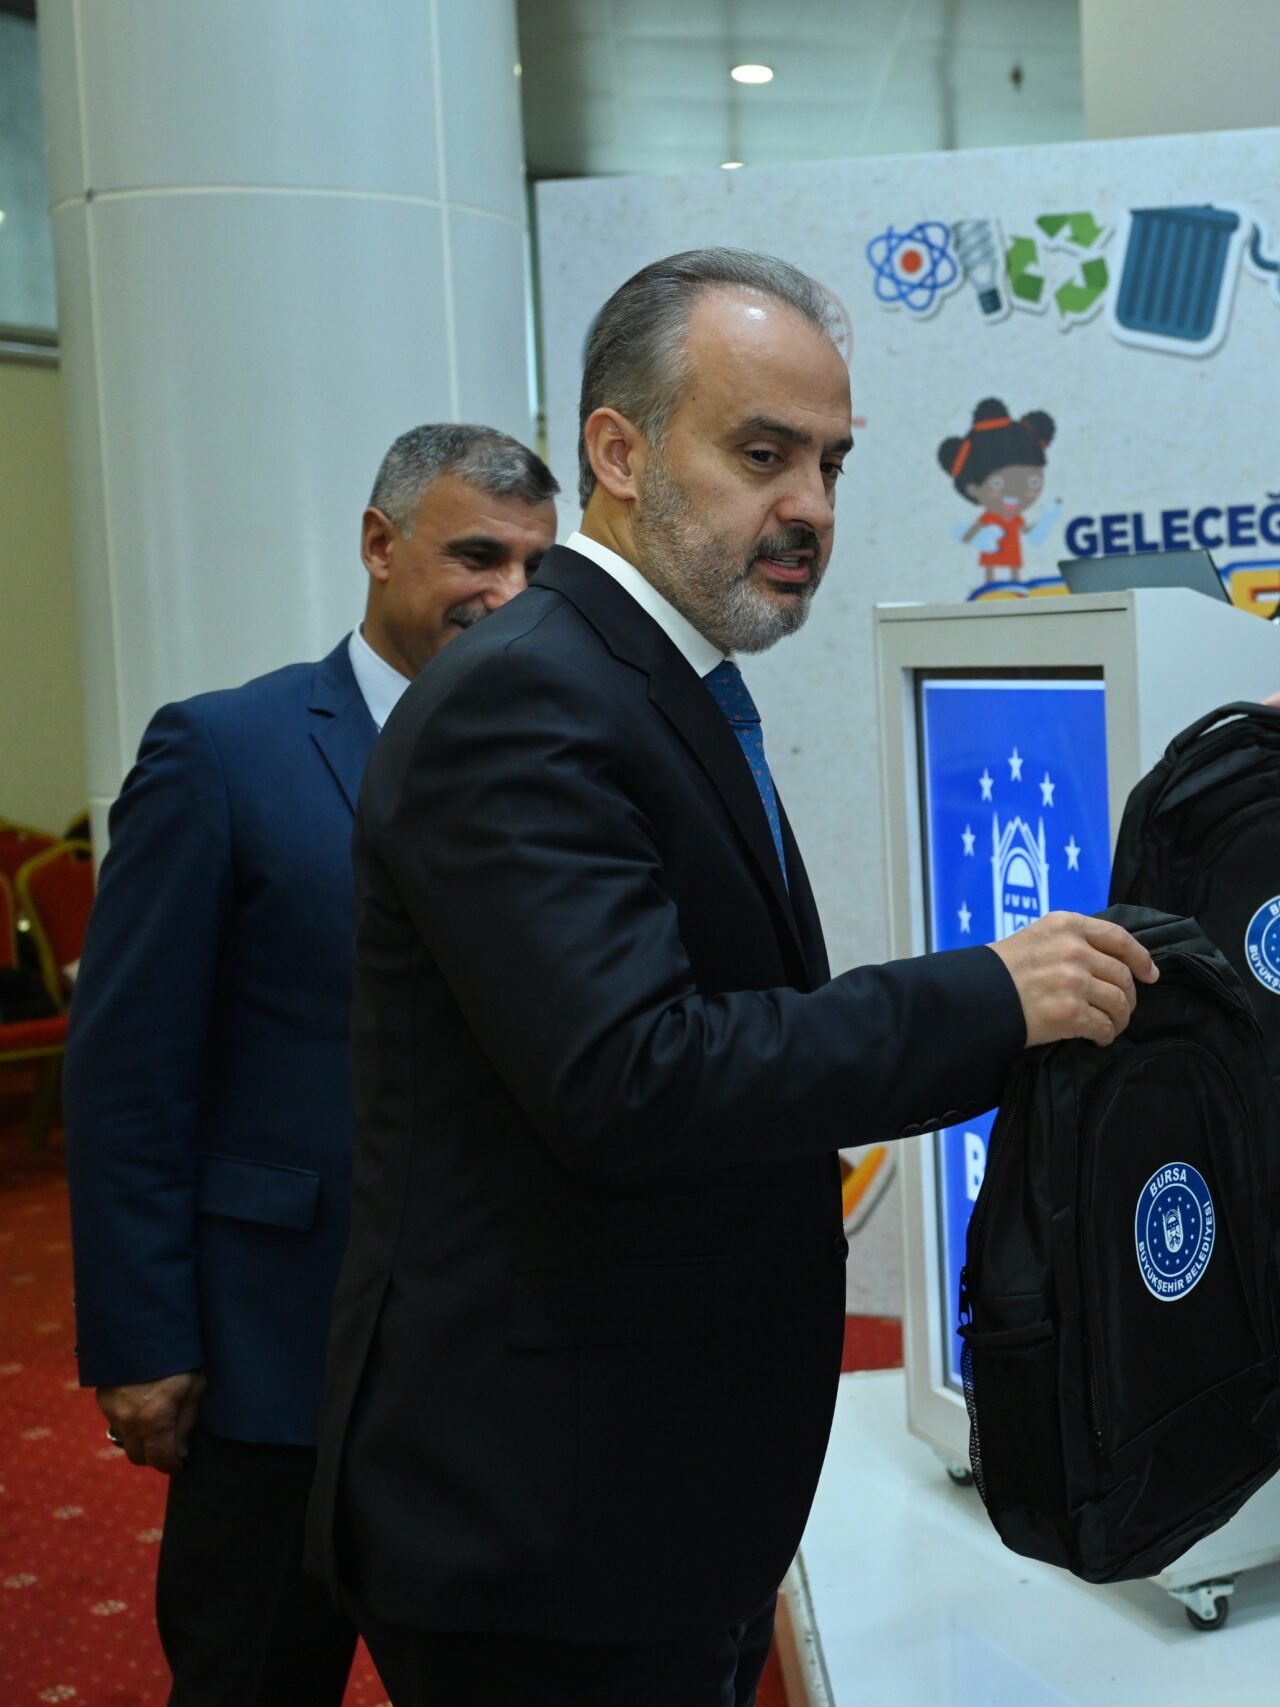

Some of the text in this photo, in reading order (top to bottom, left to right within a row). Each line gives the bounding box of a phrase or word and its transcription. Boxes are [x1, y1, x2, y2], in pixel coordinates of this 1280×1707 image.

[1149, 1167, 1188, 1198] BURSA
[1138, 1200, 1212, 1293] BÜYÜKŞEHİR BELEDİYESİ
